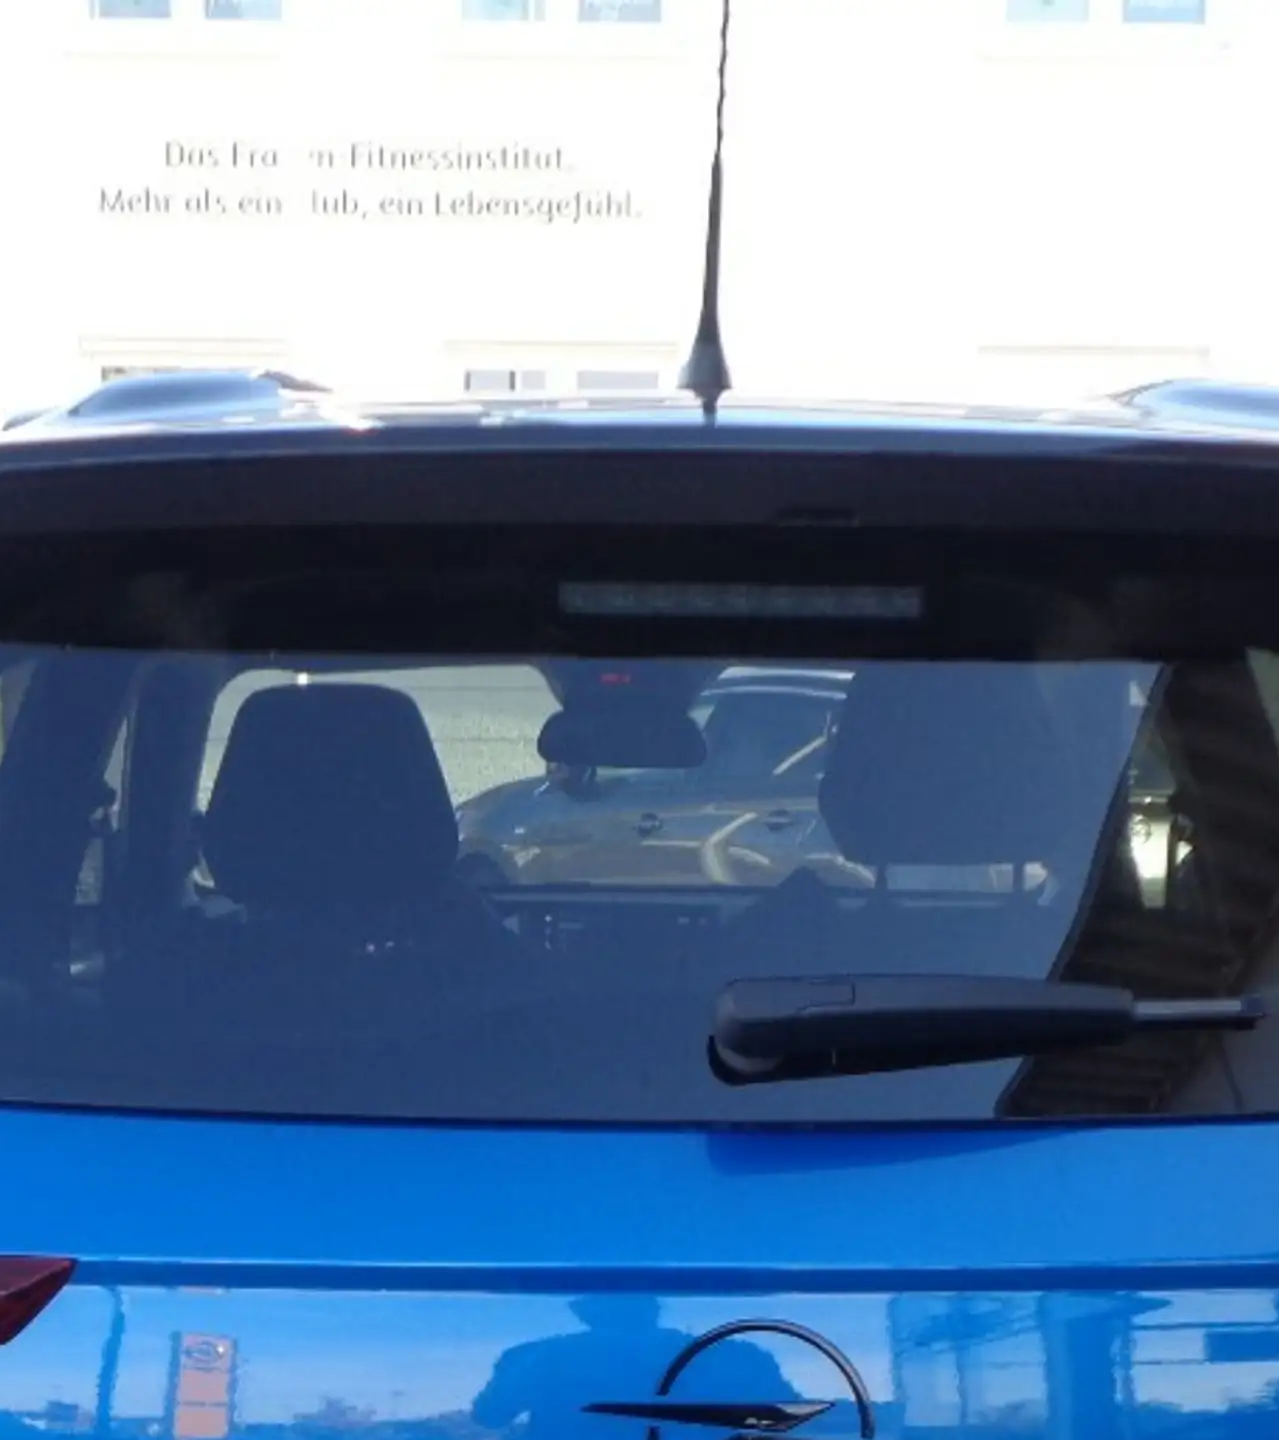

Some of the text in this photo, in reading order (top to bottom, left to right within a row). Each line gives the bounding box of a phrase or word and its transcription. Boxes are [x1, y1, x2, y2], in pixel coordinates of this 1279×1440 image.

[164, 139, 219, 169] Das
[231, 140, 334, 170] Fran
[99, 186, 172, 215] Mehr
[184, 186, 227, 215] als
[237, 188, 283, 216] ein
[301, 187, 368, 220] lub,
[378, 189, 424, 217] ein
